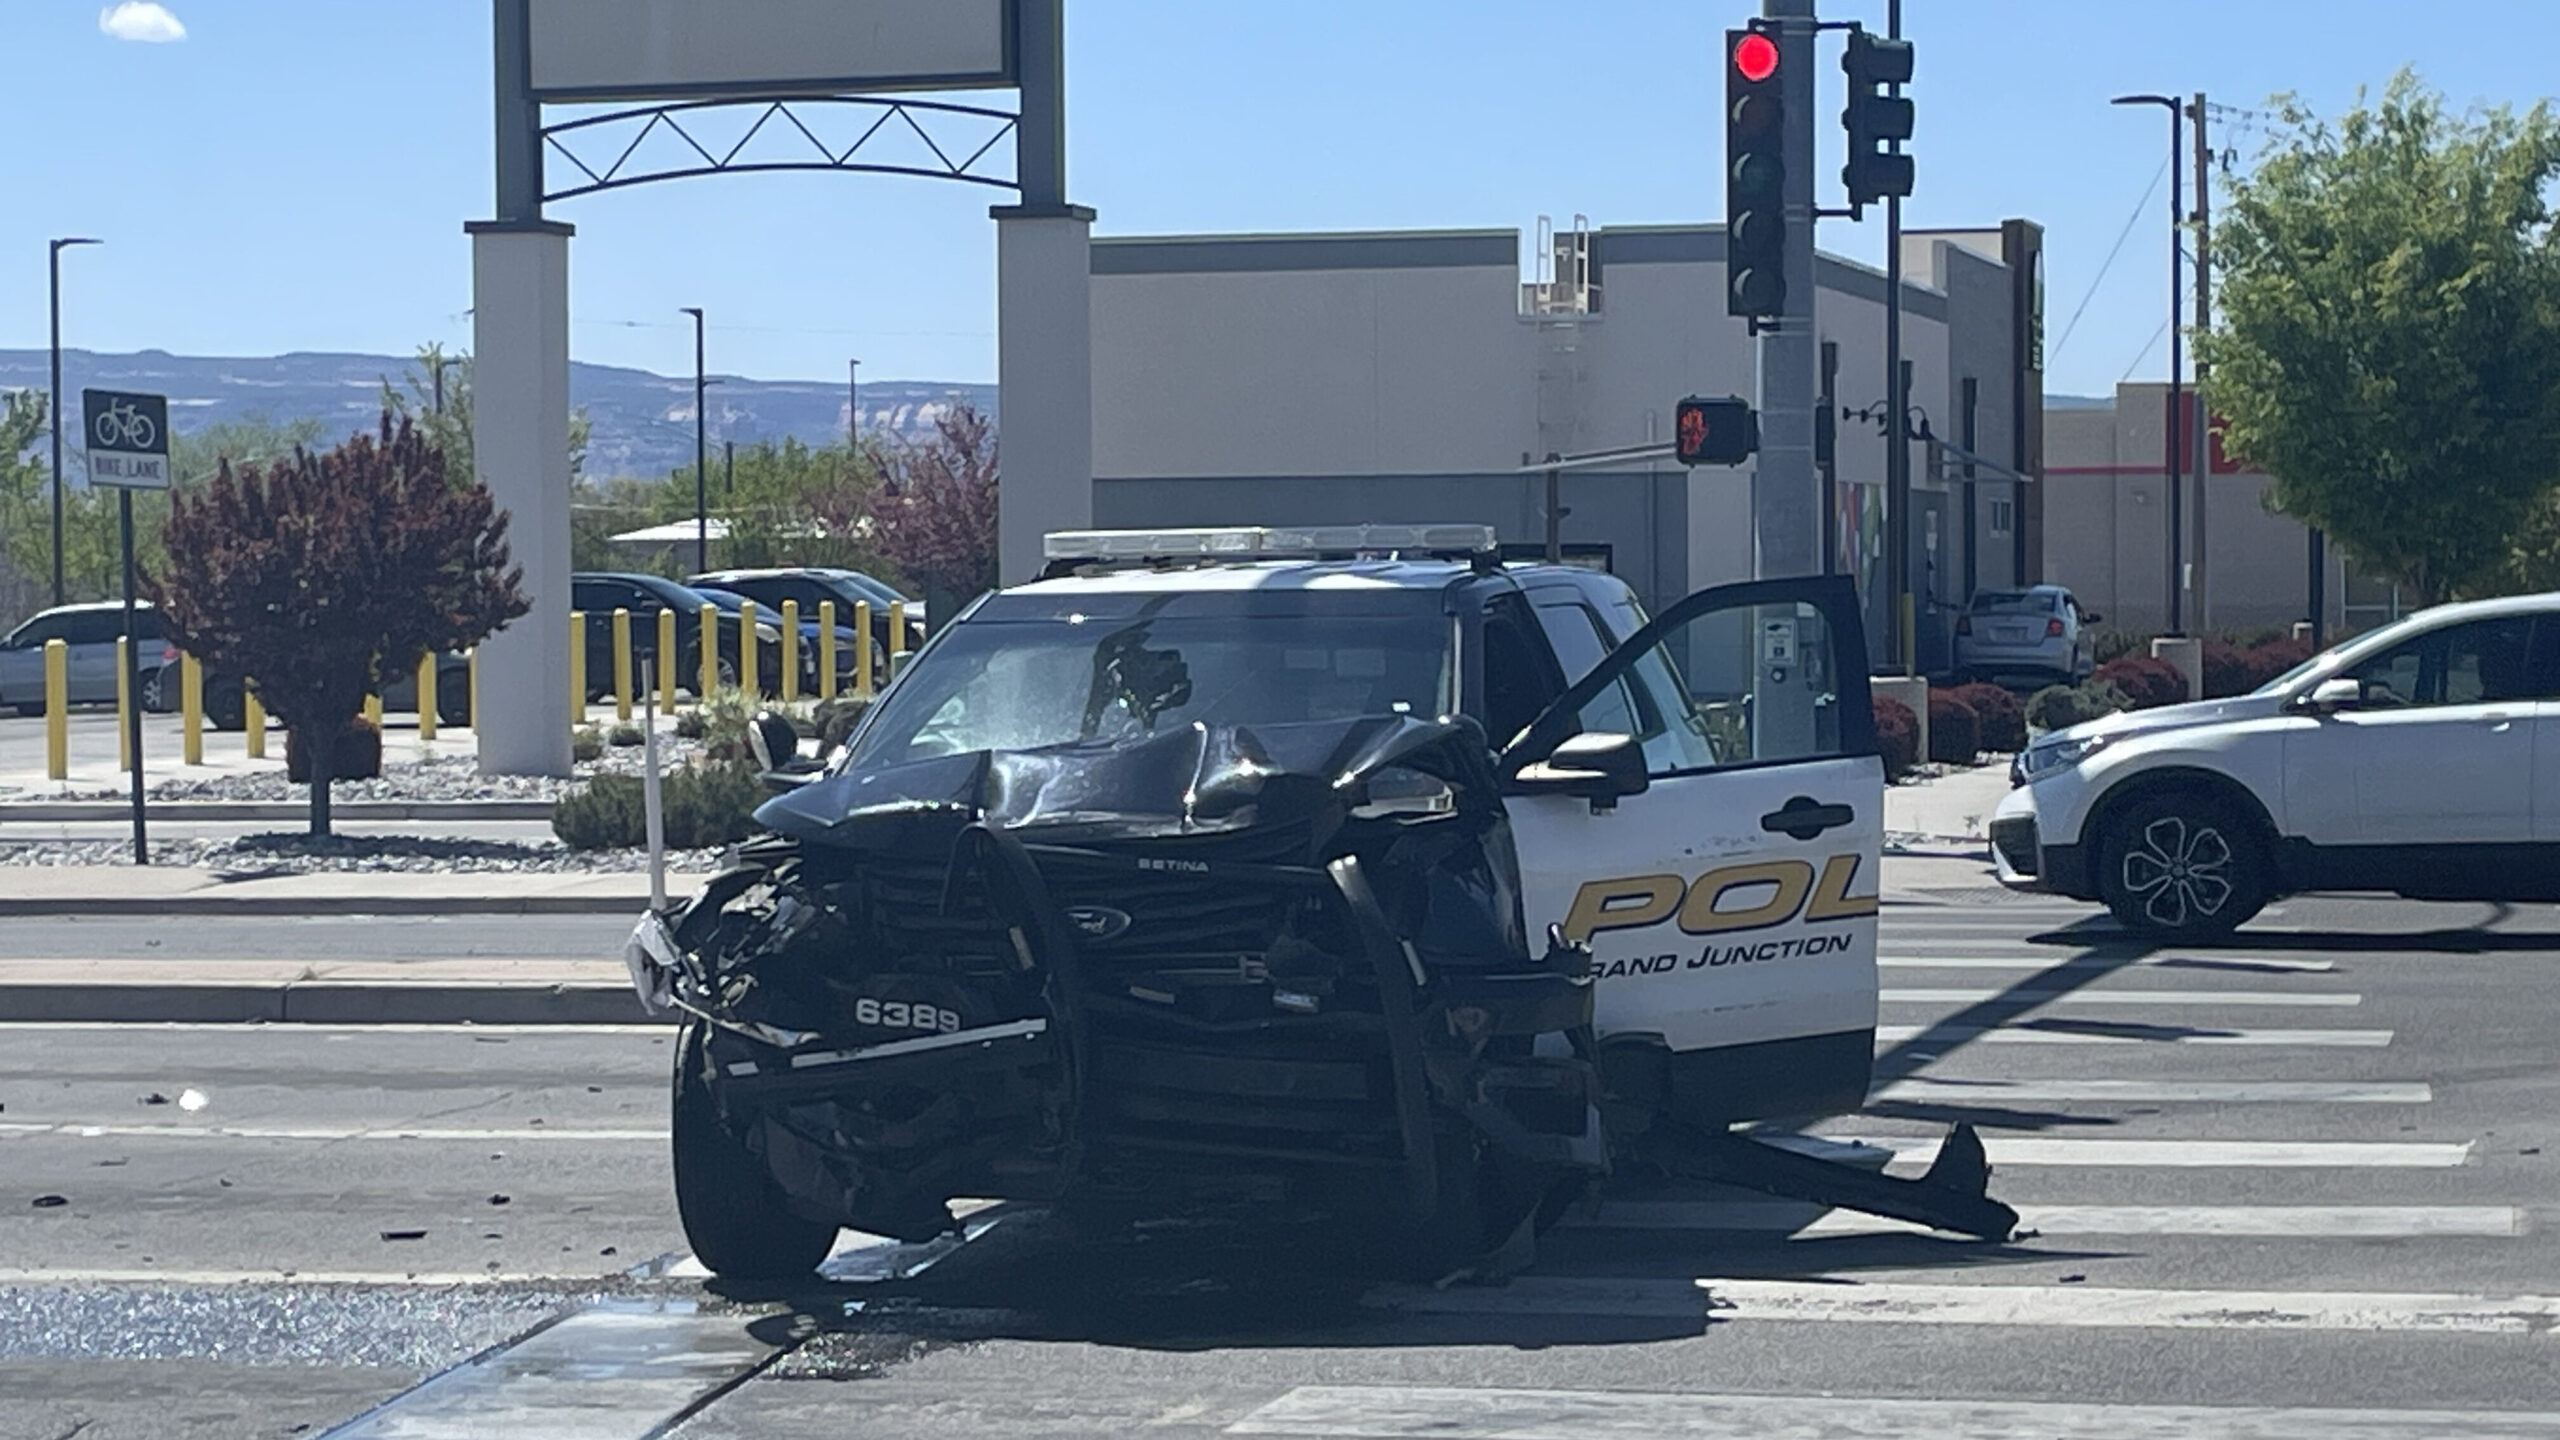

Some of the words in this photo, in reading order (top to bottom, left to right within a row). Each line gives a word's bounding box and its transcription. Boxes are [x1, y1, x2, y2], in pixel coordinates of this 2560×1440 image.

[95, 457, 122, 477] BIKE
[125, 458, 161, 480] LANE
[1563, 853, 1879, 949] POL
[1591, 954, 1678, 979] RAND
[1687, 933, 1853, 969] JUNCTION
[856, 998, 960, 1033] 6389
